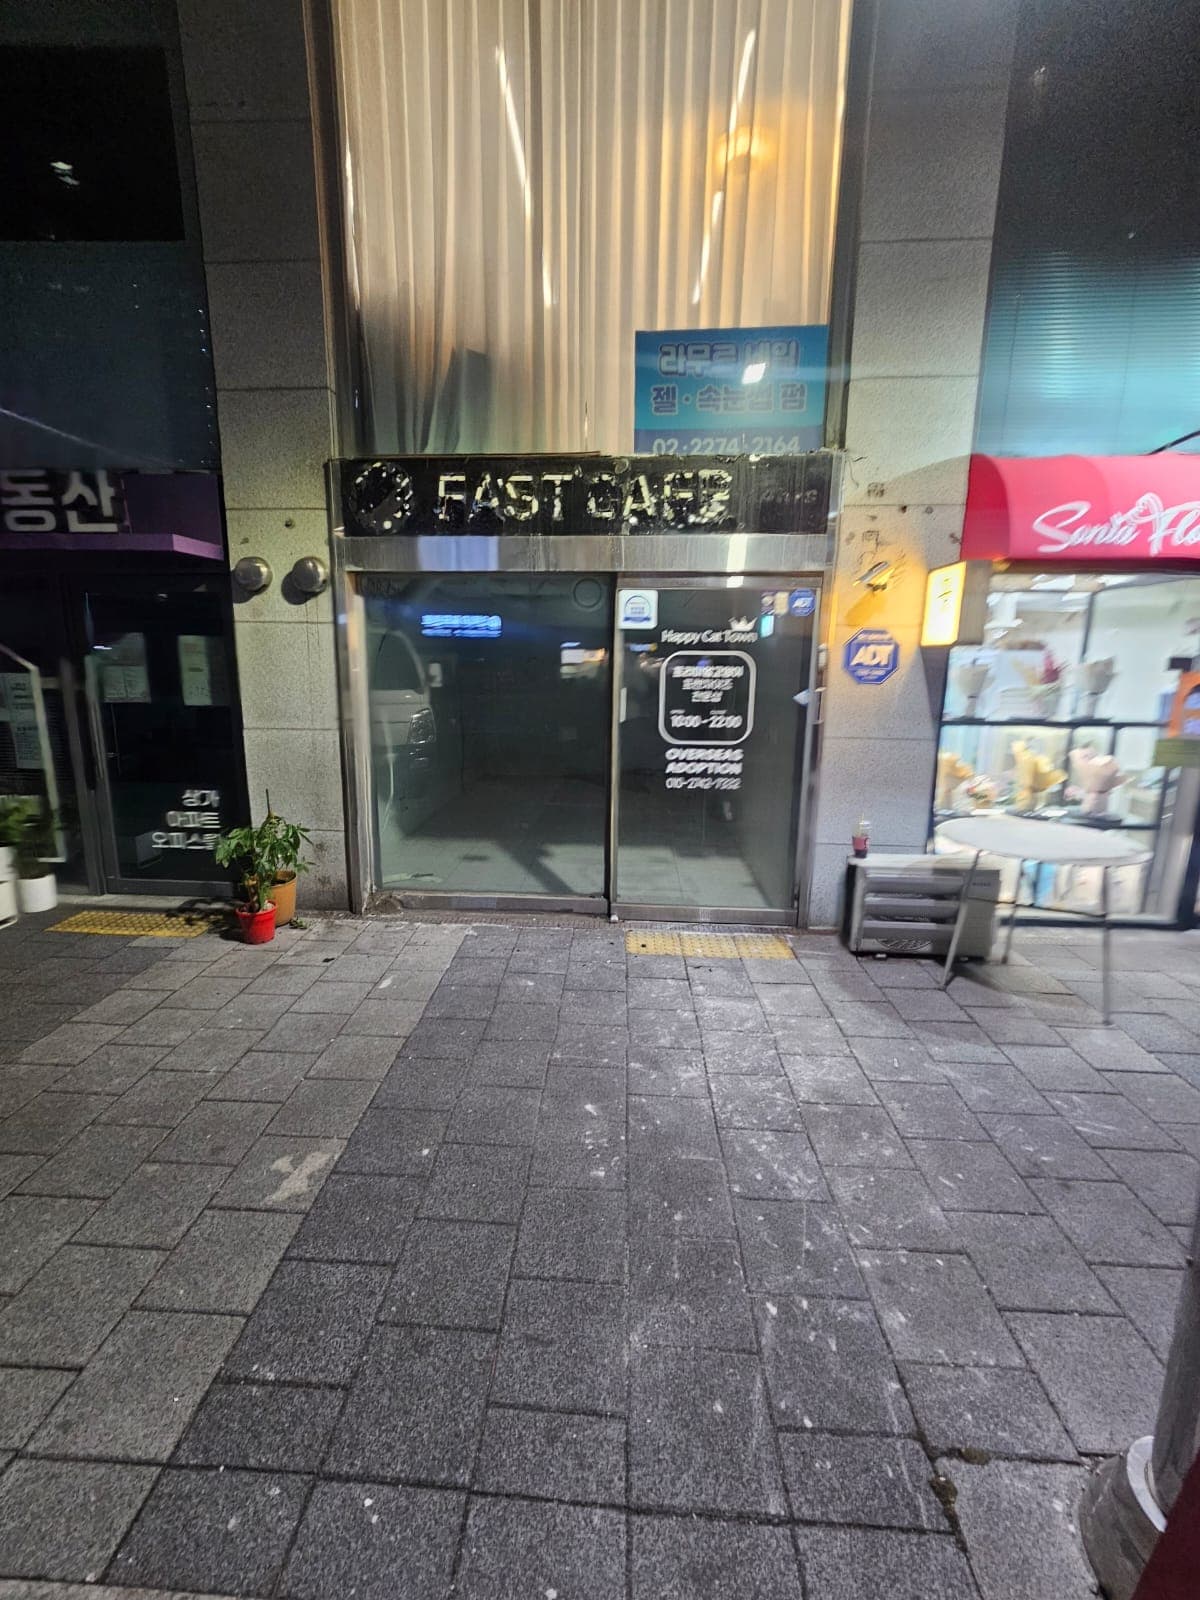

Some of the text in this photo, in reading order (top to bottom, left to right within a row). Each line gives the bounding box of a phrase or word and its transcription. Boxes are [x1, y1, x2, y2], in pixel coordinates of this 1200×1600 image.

[0, 468, 119, 533] 동산
[434, 472, 573, 521] FAST
[661, 629, 701, 645] Happy
[850, 644, 895, 667] ADT
[665, 761, 743, 775] ADOPTION
